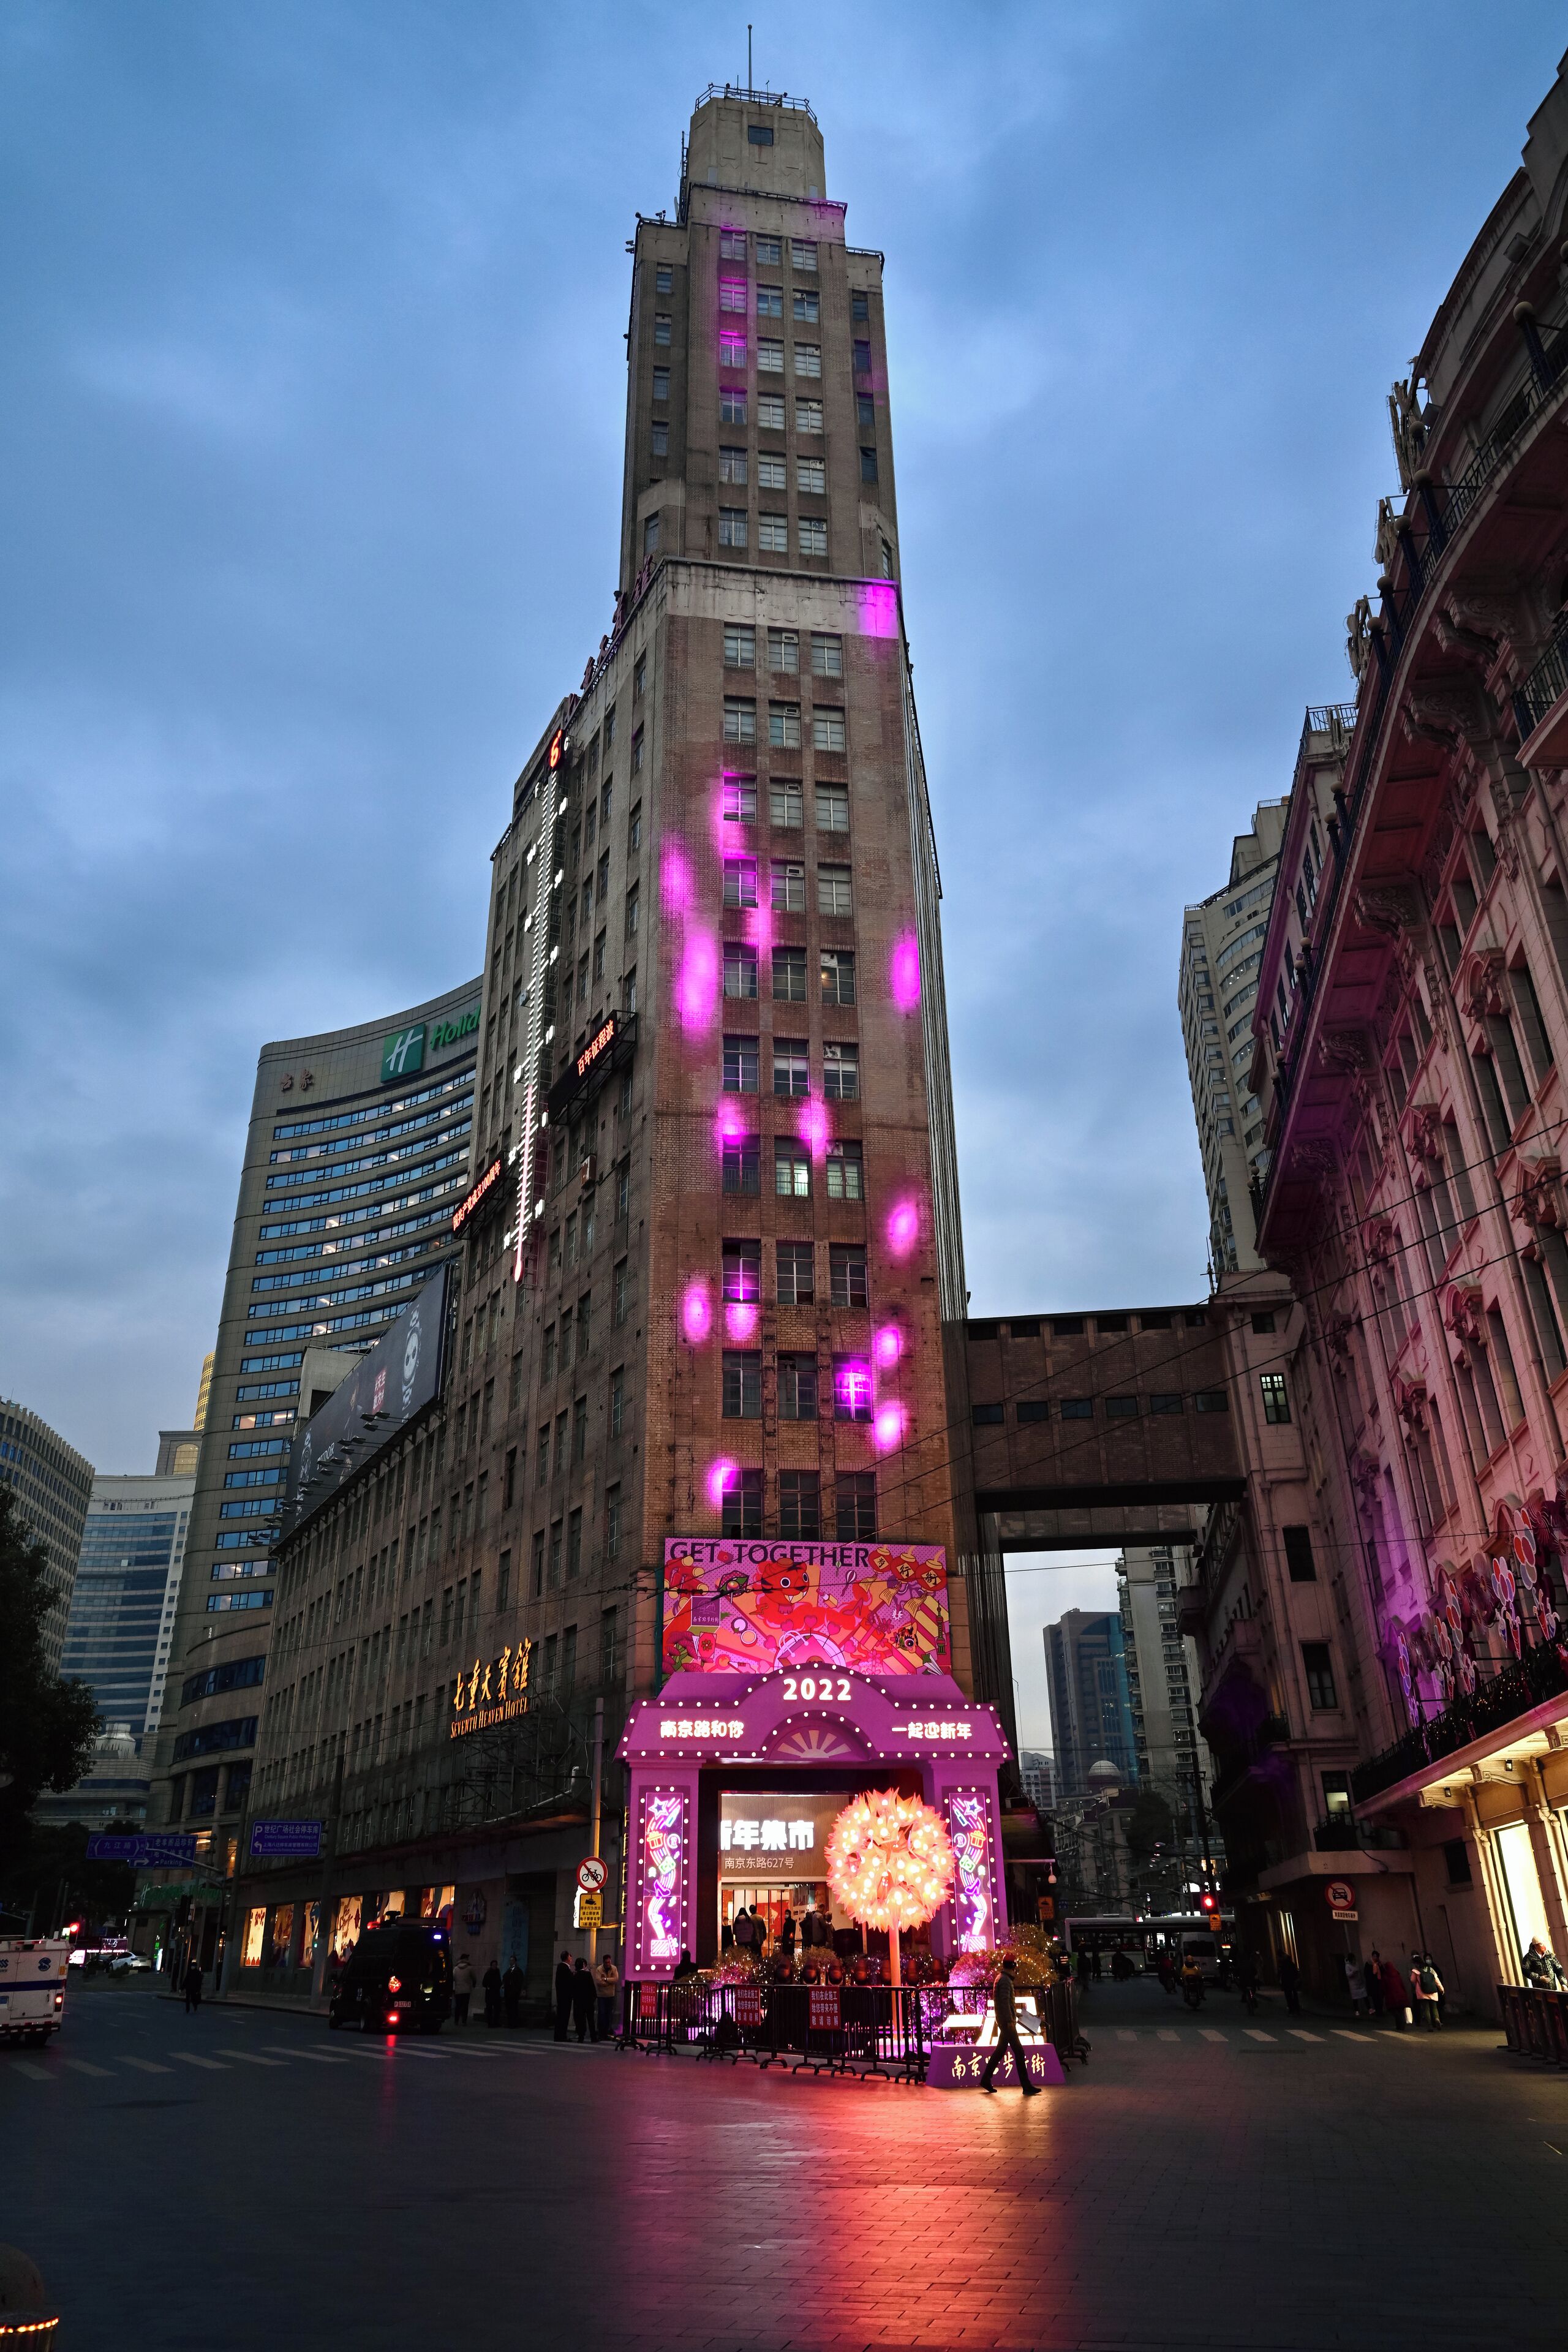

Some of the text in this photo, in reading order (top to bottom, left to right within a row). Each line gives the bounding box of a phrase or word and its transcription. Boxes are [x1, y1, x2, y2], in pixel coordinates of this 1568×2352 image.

[577, 1020, 614, 1076] 百年征程波
[453, 1159, 500, 1231] 国共产党成立100周年
[670, 1542, 870, 1568] GET TOGETHER
[877, 1558, 938, 1585] 步行街
[784, 1678, 851, 1700] 2022
[451, 1697, 529, 1739] SEVENTH HEAVEN HOTEL
[661, 1720, 744, 1738] 南京路和你
[892, 1722, 973, 1740] 一起迎新年
[265, 1825, 319, 1834] 世纪广场社会停车库
[725, 1857, 794, 1869] 南京东路627号
[811, 1991, 837, 2000] 我们在此施工
[812, 2003, 838, 2013] 给您带来不便
[812, 2016, 839, 2026] 敬请谅解
